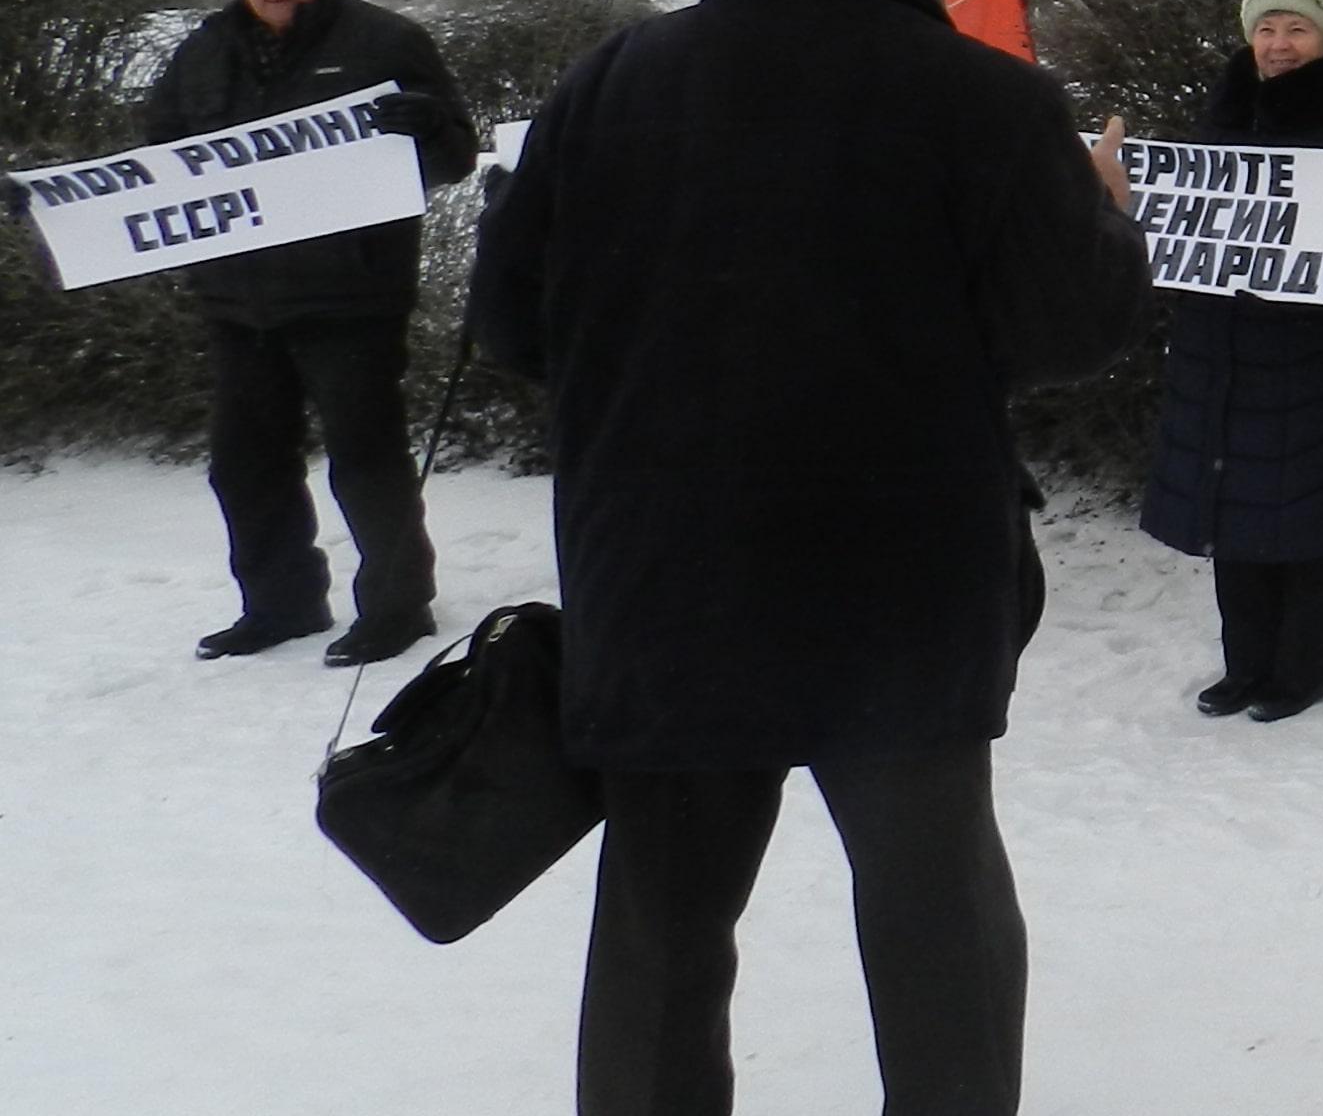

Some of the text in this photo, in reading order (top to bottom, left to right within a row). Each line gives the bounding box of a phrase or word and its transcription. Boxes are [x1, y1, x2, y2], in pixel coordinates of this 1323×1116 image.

[28, 102, 386, 207] МОЯ РОДИНА
[1090, 139, 1294, 198] ЕРНИТЕ
[124, 187, 264, 253] СССР!
